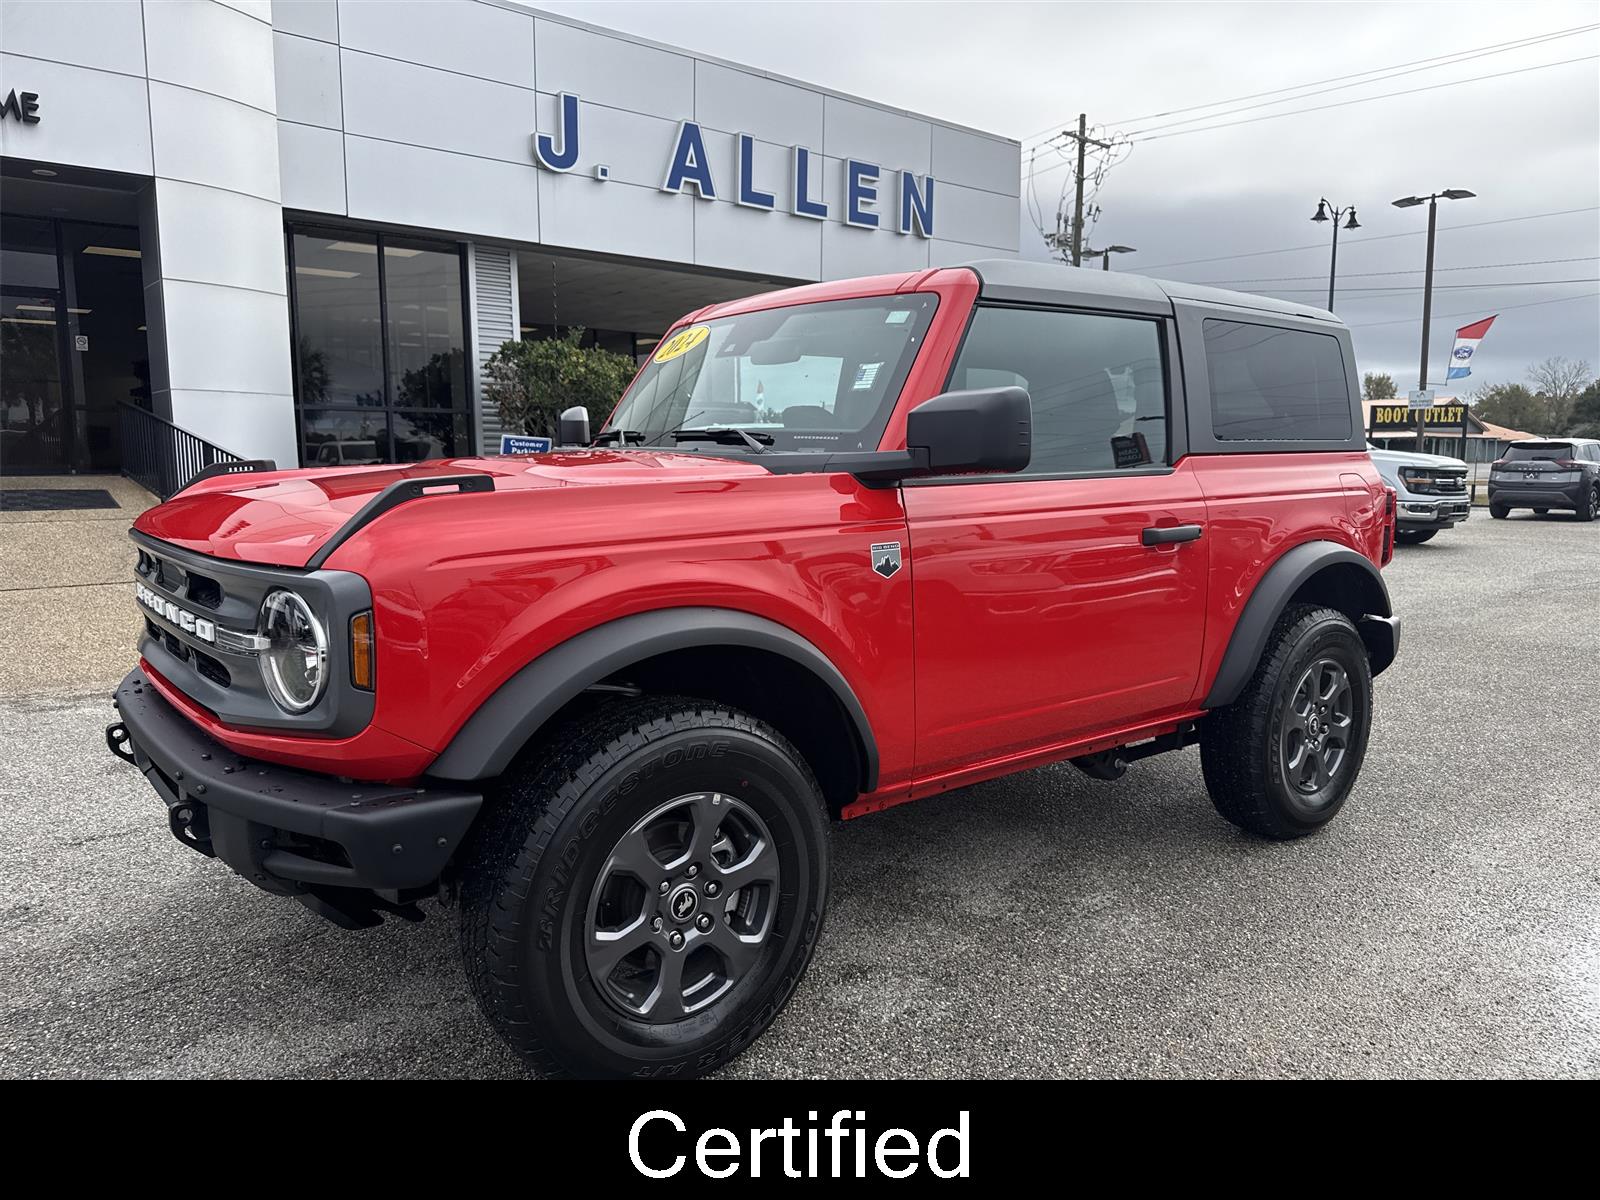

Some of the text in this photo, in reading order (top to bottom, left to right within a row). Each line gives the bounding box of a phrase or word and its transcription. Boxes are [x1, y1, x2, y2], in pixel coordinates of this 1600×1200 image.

[660, 119, 935, 238] ALLEN
[657, 328, 705, 359] 2024
[1375, 407, 1409, 423] BOOT
[510, 439, 543, 448] Customer
[136, 582, 215, 642] BRONCO
